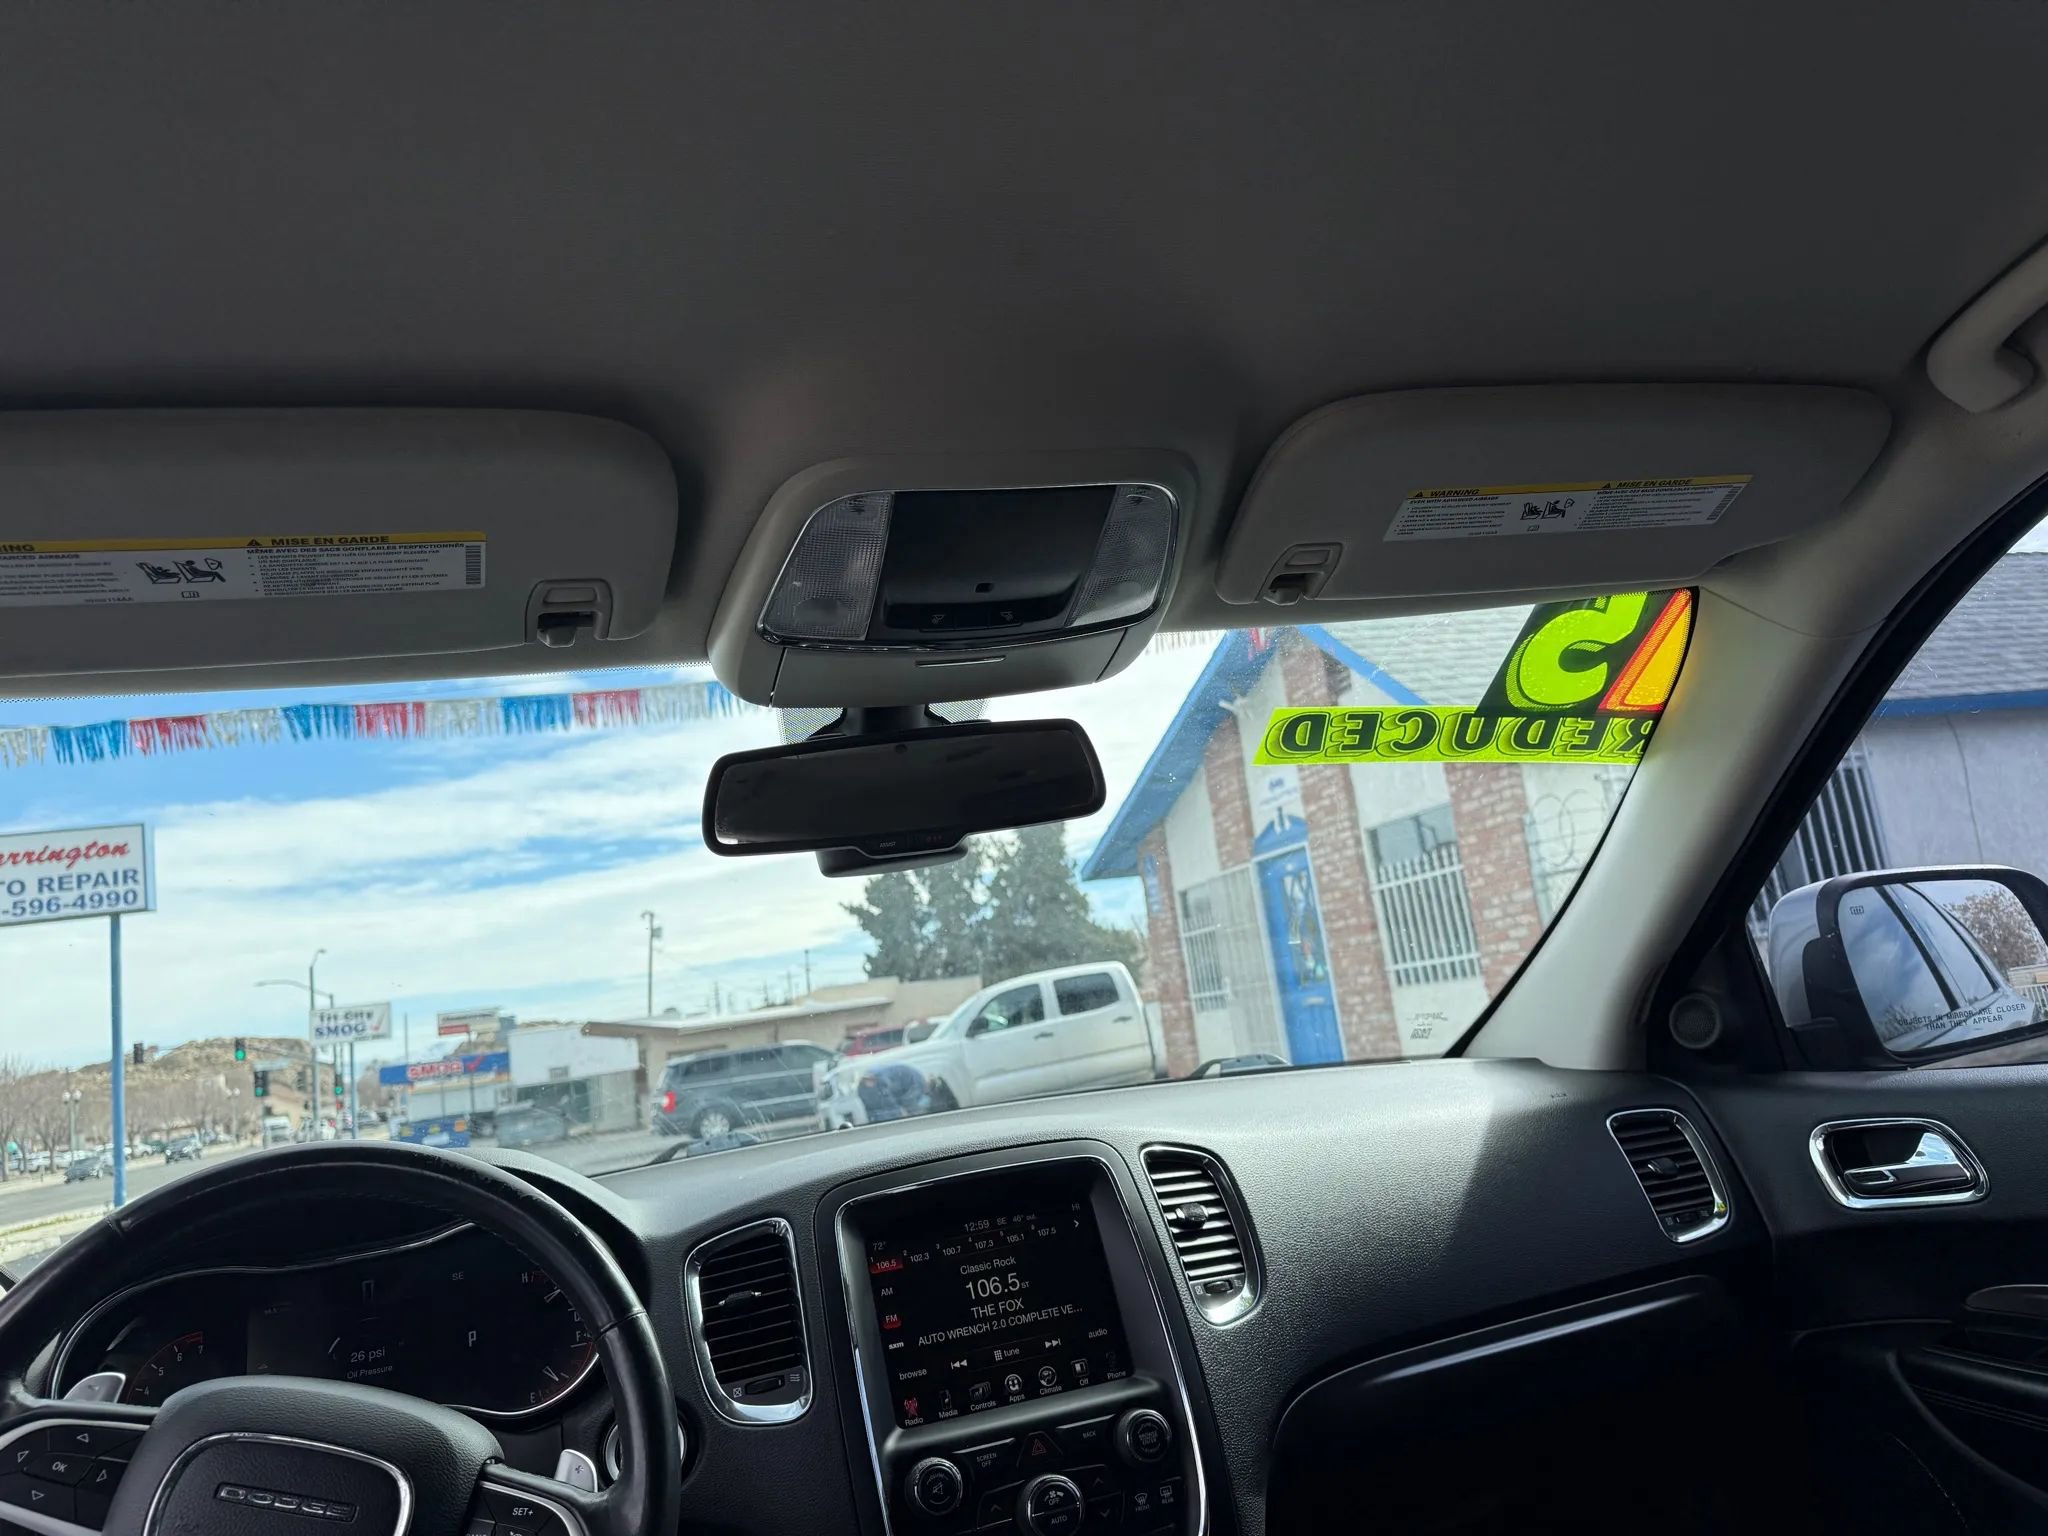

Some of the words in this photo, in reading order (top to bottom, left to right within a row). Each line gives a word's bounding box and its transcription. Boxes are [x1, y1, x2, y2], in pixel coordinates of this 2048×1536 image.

[1658, 479, 1692, 487] GARDE
[1430, 489, 1480, 497] WARNING
[272, 538, 309, 546] MISE
[314, 537, 335, 545] EN
[338, 536, 390, 544] GARDE
[37, 868, 140, 894] REPAIR
[1898, 1015, 1932, 1026] OBJECTS
[1946, 1010, 1974, 1020] MIRROR
[1978, 1008, 1993, 1016] ARE
[1996, 1003, 2027, 1013] CLOSER
[1925, 1023, 1946, 1031] THAN
[1950, 1019, 1968, 1028] THEY
[1972, 1015, 2004, 1025] APPEAR
[315, 1023, 367, 1038] SMOG
[964, 1219, 990, 1232] 12:59
[996, 1217, 1007, 1226] SE
[1038, 1226, 1057, 1237] 107.5
[1006, 1233, 1025, 1244] 105.1
[975, 1240, 994, 1250] 107.3
[910, 1252, 930, 1263] 102.3
[943, 1246, 962, 1257] 100.7
[876, 1258, 897, 1270] 106.5
[960, 1262, 992, 1275] Classic
[993, 1256, 1017, 1269] Rock
[881, 1287, 894, 1297] AM
[965, 1272, 1020, 1300] 106.5
[970, 1304, 997, 1319] THE
[998, 1298, 1025, 1314] FOX
[885, 1314, 898, 1324] FM
[918, 1332, 946, 1347] AUTO
[947, 1323, 991, 1340] WRENCH
[992, 1319, 1007, 1330] 2.0
[1008, 1307, 1060, 1327] COMPLETE
[468, 1330, 477, 1347] P
[1088, 1328, 1108, 1339] audio
[888, 1341, 905, 1350] sxm
[177, 1352, 183, 1362] 6
[350, 1351, 366, 1364] 26
[368, 1347, 386, 1362] psi
[1003, 1347, 1020, 1358] tune
[158, 1366, 164, 1376] 5
[347, 1369, 358, 1380] Oil
[359, 1365, 393, 1377] Pressure
[899, 1368, 928, 1381] browse
[143, 1385, 150, 1397] 4
[530, 1392, 537, 1404] E
[905, 1417, 924, 1427] Radio
[938, 1408, 959, 1419] Media
[970, 1400, 997, 1412] Controls
[1009, 1393, 1026, 1404] Apps
[1039, 1385, 1063, 1396] Climate
[1106, 1370, 1127, 1380] Phone
[1082, 1430, 1097, 1440] BACK
[976, 1453, 997, 1464] SCREEN
[981, 1460, 992, 1468] OFF
[52, 1460, 68, 1474] OK
[219, 1485, 357, 1519] DODGE
[512, 1507, 534, 1517] SET+
[1050, 1515, 1069, 1527] AUTO
